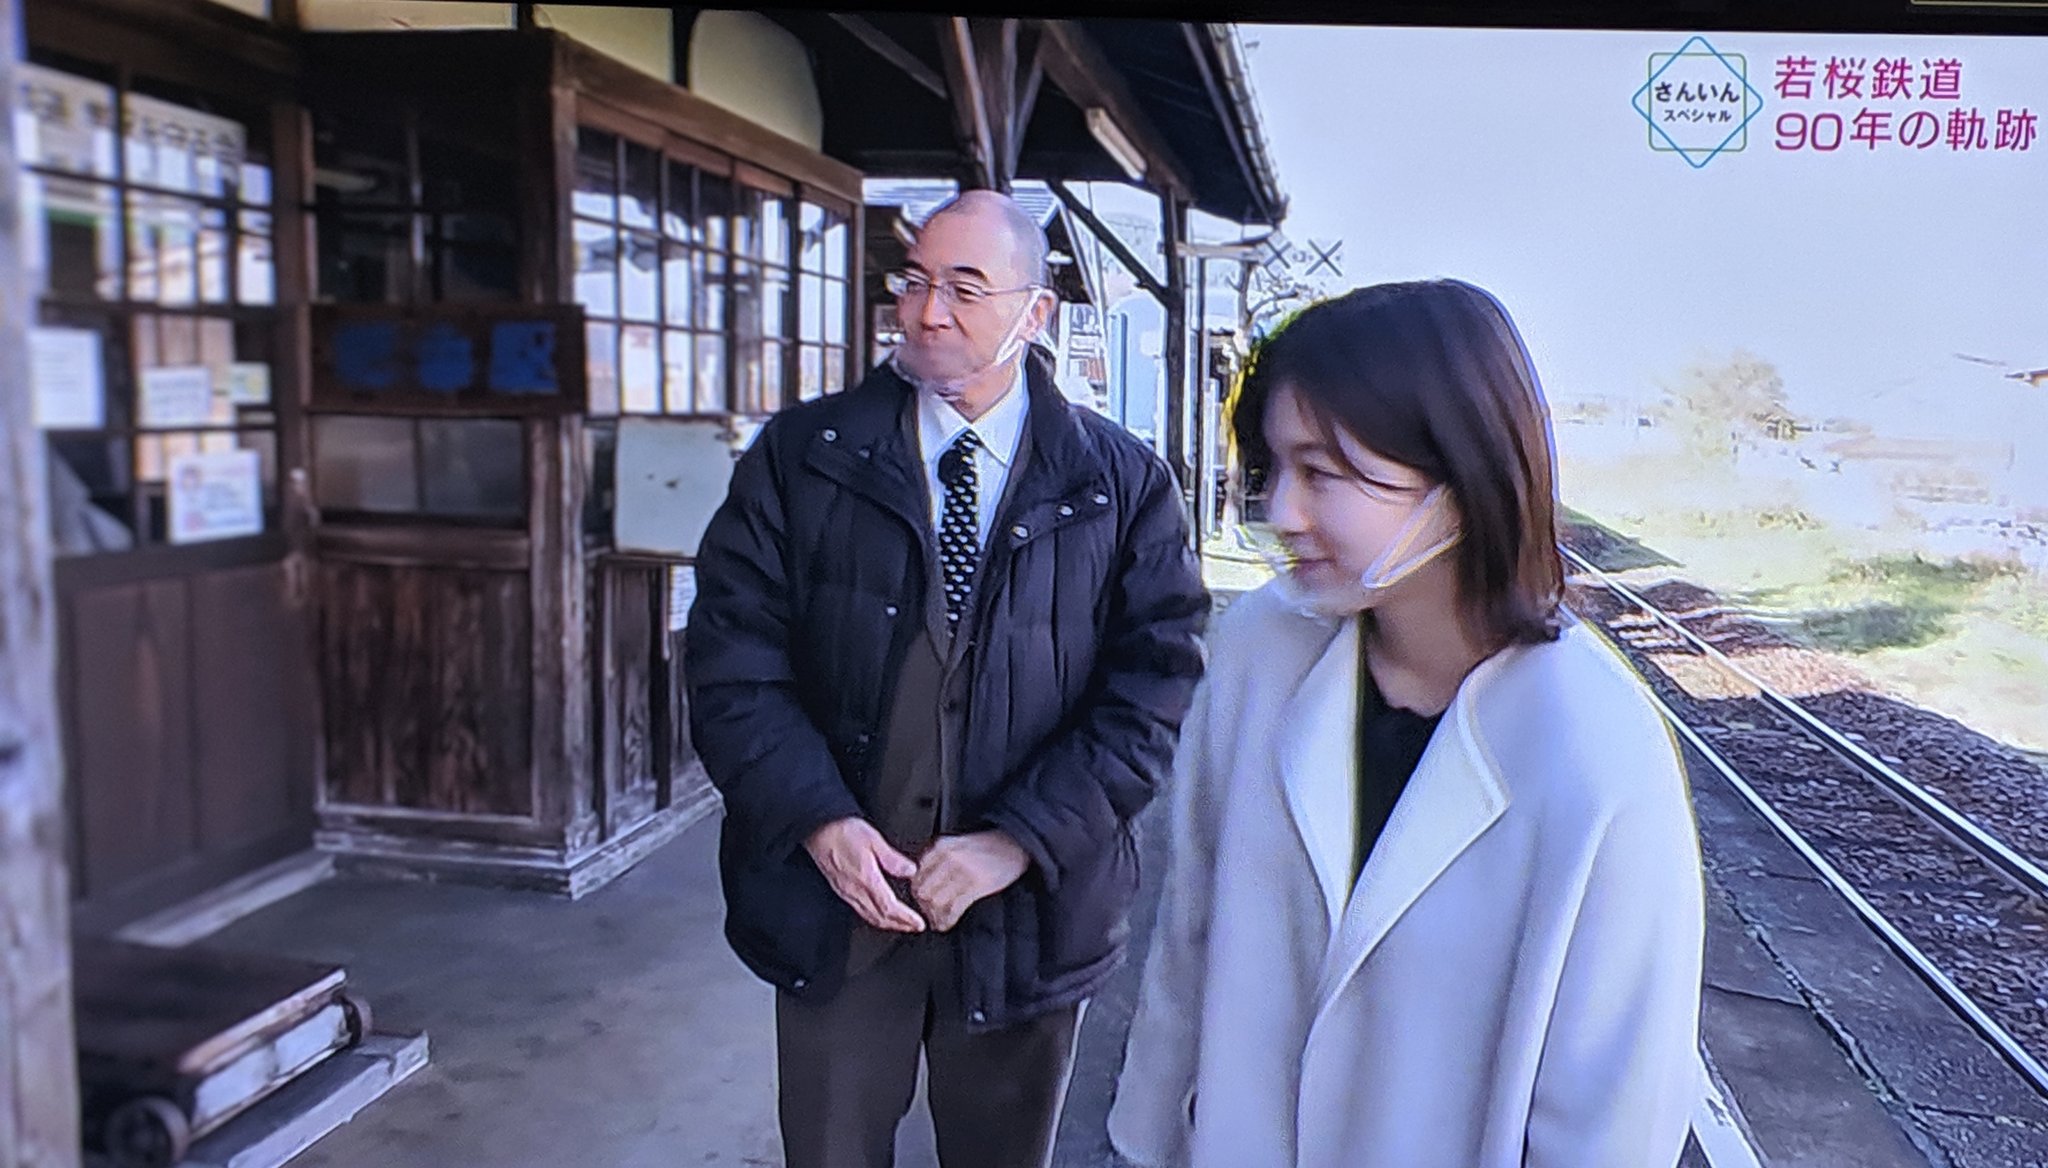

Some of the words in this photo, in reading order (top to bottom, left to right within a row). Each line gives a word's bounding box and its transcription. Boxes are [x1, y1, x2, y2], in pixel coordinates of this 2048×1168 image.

[1655, 81, 1740, 102] さんいん
[1774, 55, 1962, 100] 若桜鉄道
[1664, 108, 1732, 123] スペシャル
[1775, 107, 2037, 152] 90年の軌跡
